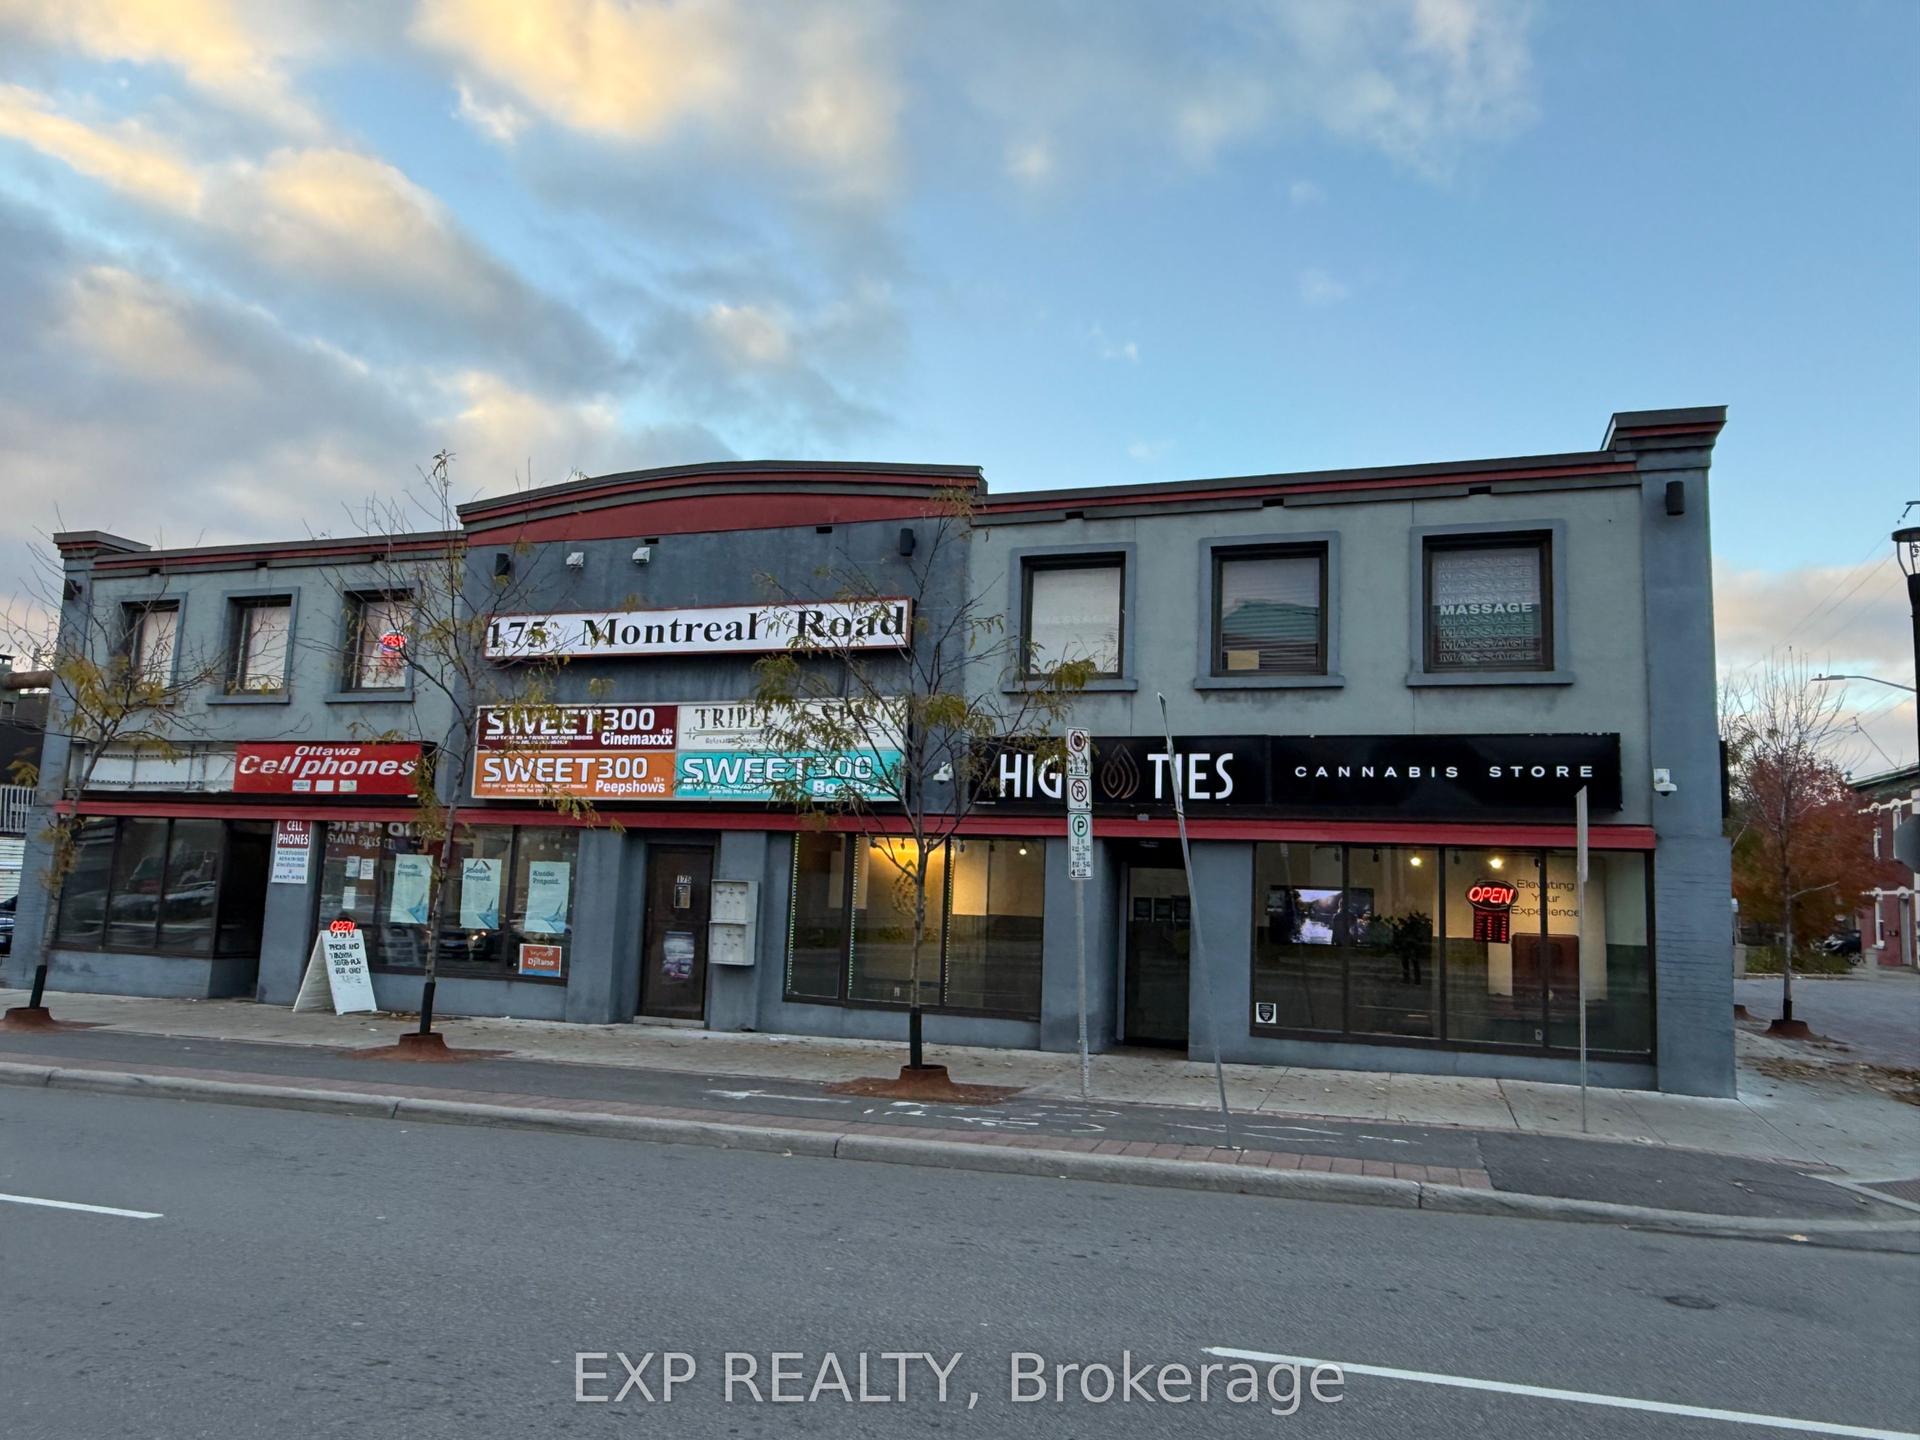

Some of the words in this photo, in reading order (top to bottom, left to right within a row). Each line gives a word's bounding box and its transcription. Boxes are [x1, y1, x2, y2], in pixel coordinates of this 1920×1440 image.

[1440, 602, 1533, 615] MASSAGE
[490, 621, 546, 648] 175
[578, 612, 758, 647] Montreal
[797, 606, 905, 638] Road
[485, 708, 602, 735] SWEET
[603, 708, 655, 731] 300
[601, 731, 673, 746] Cinemaxxx
[294, 745, 361, 756] Ottawa
[239, 755, 418, 778] Cellphones
[483, 757, 596, 783] SWEET
[597, 757, 648, 779] 300
[683, 756, 811, 784] SWEET
[813, 755, 873, 779] 300
[1294, 765, 1459, 778] CANNABIS
[1488, 765, 1593, 778] STORE
[1000, 753, 1063, 798] HIG
[1147, 753, 1234, 799] TIES
[595, 780, 666, 796] Peepshows
[286, 820, 304, 831] CELL
[278, 833, 309, 845] PHONES
[1516, 879, 1575, 892] Elevting
[1468, 886, 1514, 905] OPEN
[1530, 893, 1561, 903] Yur
[1510, 905, 1580, 918] Expeience
[330, 920, 355, 933] OPEN
